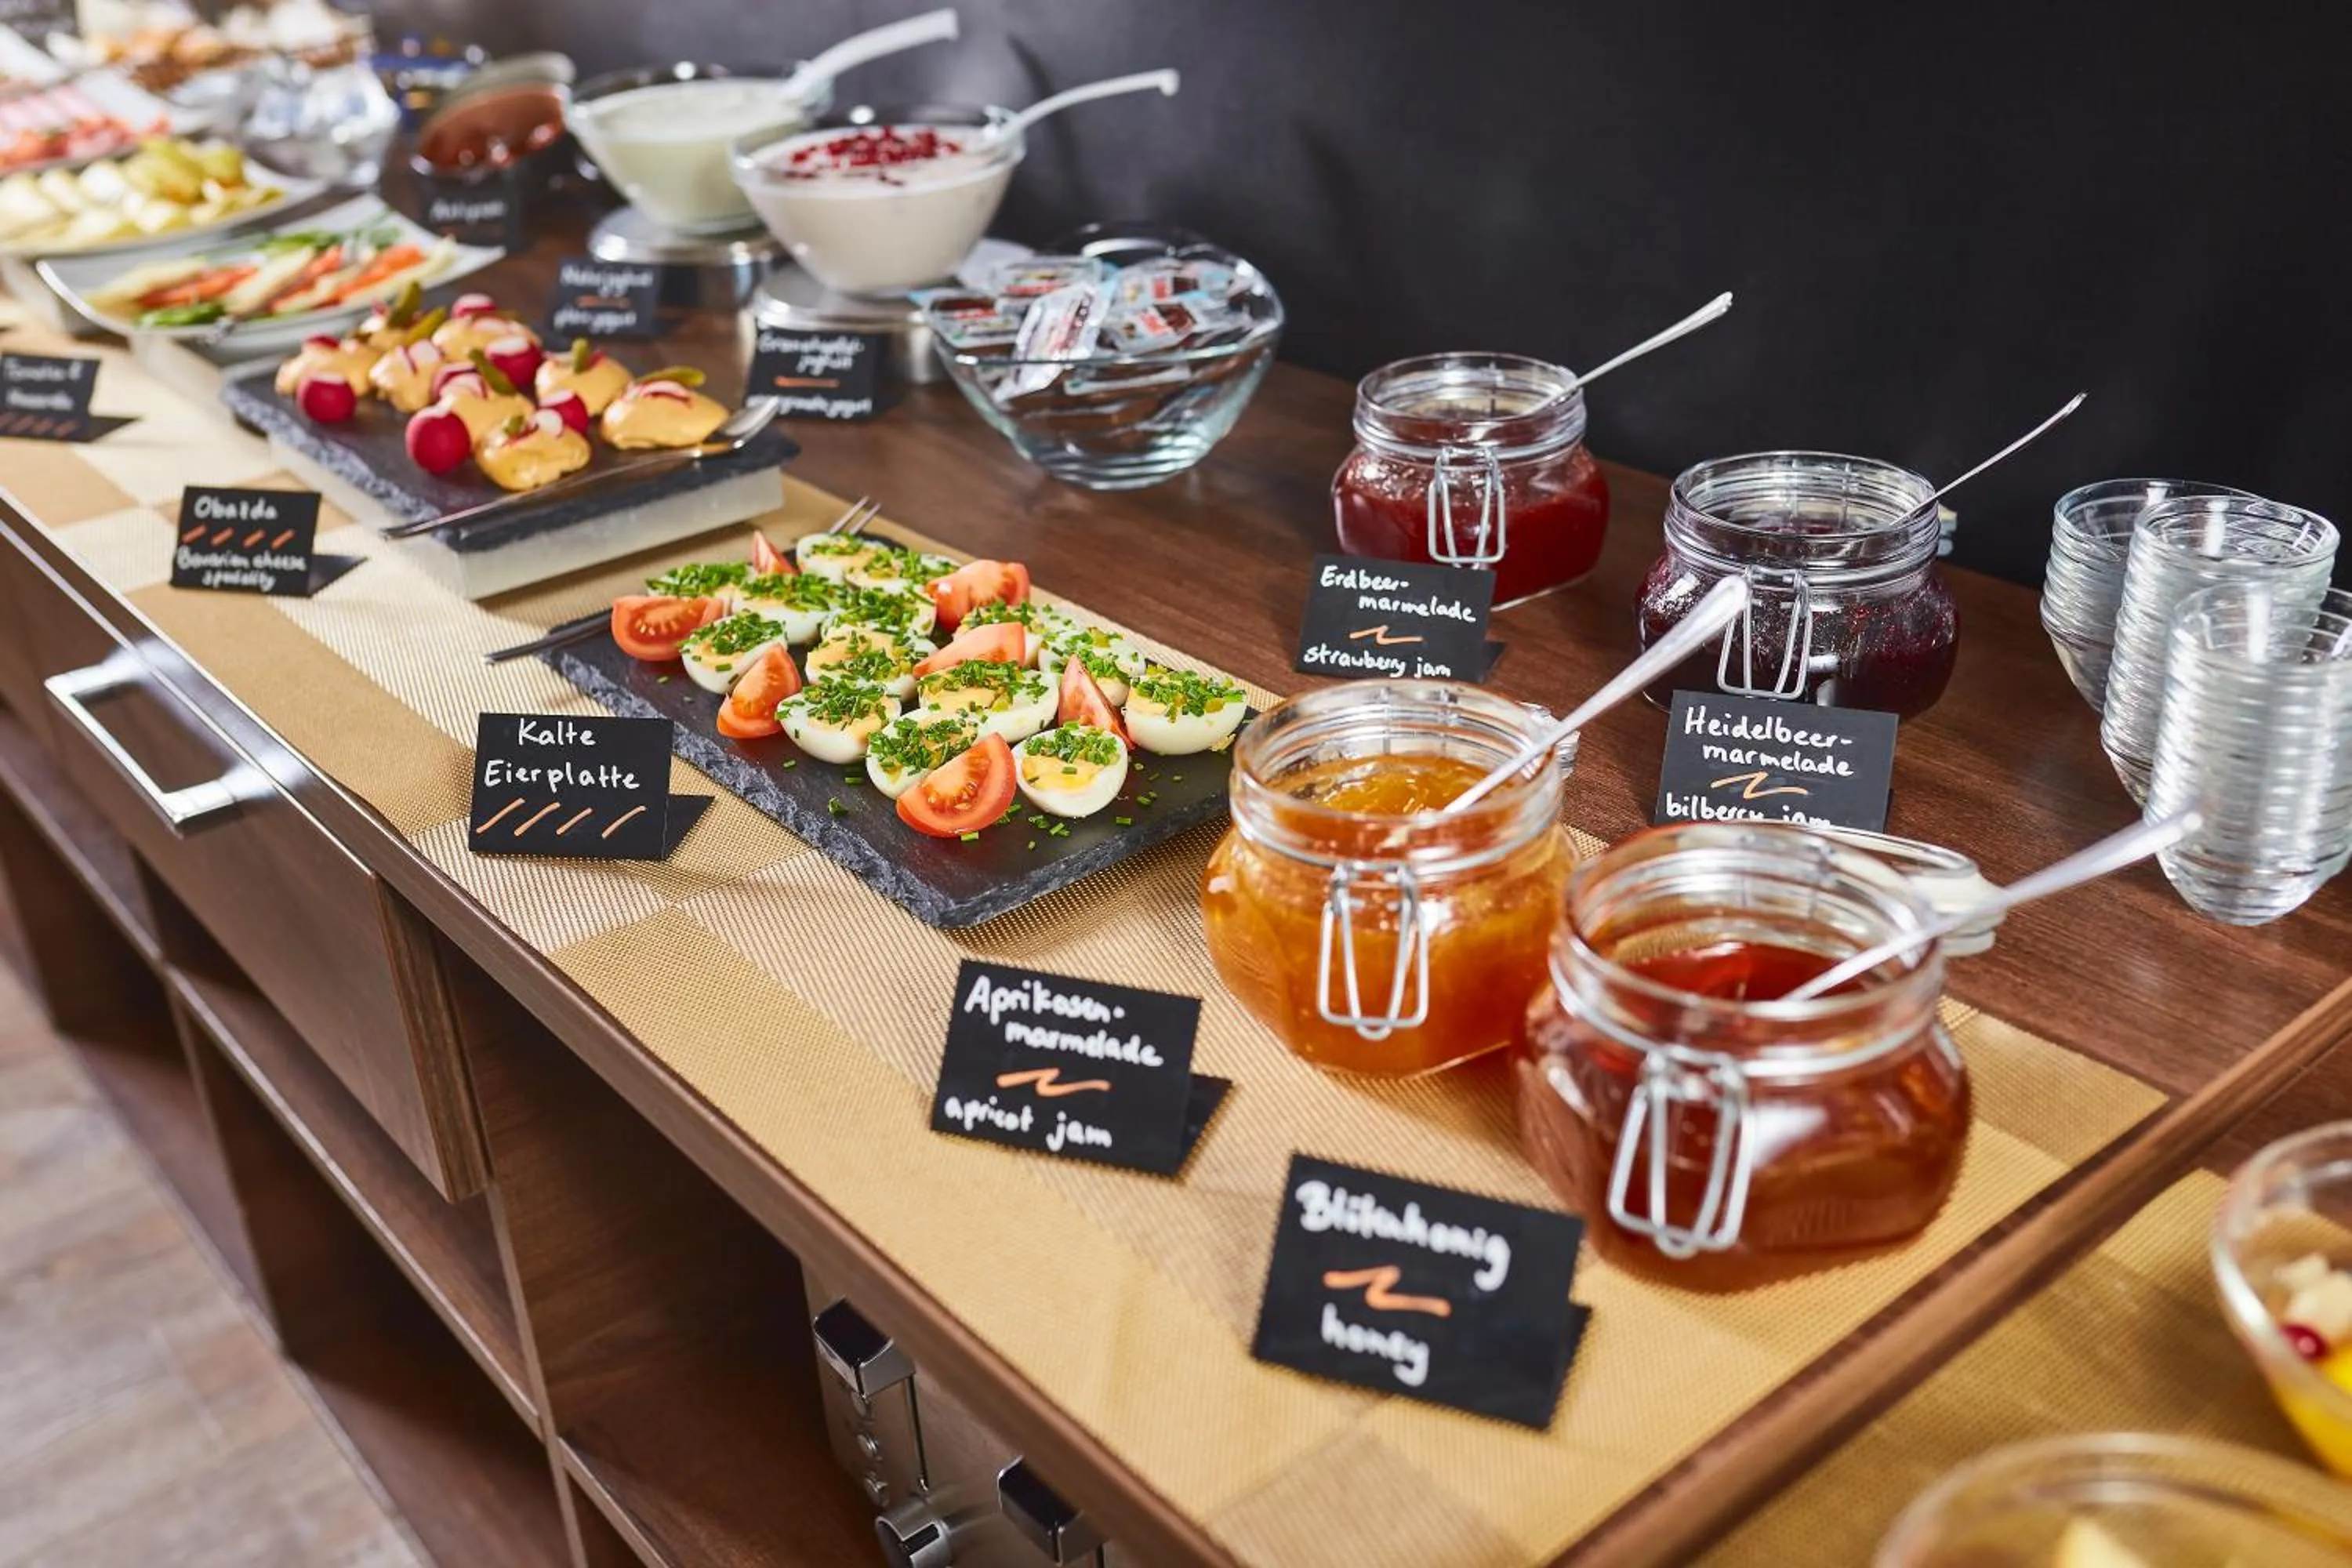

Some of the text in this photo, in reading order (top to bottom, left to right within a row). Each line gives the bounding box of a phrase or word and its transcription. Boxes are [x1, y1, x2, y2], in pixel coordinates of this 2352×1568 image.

[1320, 564, 1410, 591] Erdbeer-
[1359, 595, 1475, 622] marmelade
[1414, 657, 1451, 678] jam
[518, 717, 596, 745] Kalte
[1685, 706, 1853, 748] Heidelbeer-
[484, 759, 640, 793] Eierplatte
[1703, 744, 1853, 776] marmelade
[1005, 1021, 1163, 1066] marmelade
[944, 1095, 1112, 1151] apricot jam
[1321, 1301, 1430, 1387] honey
